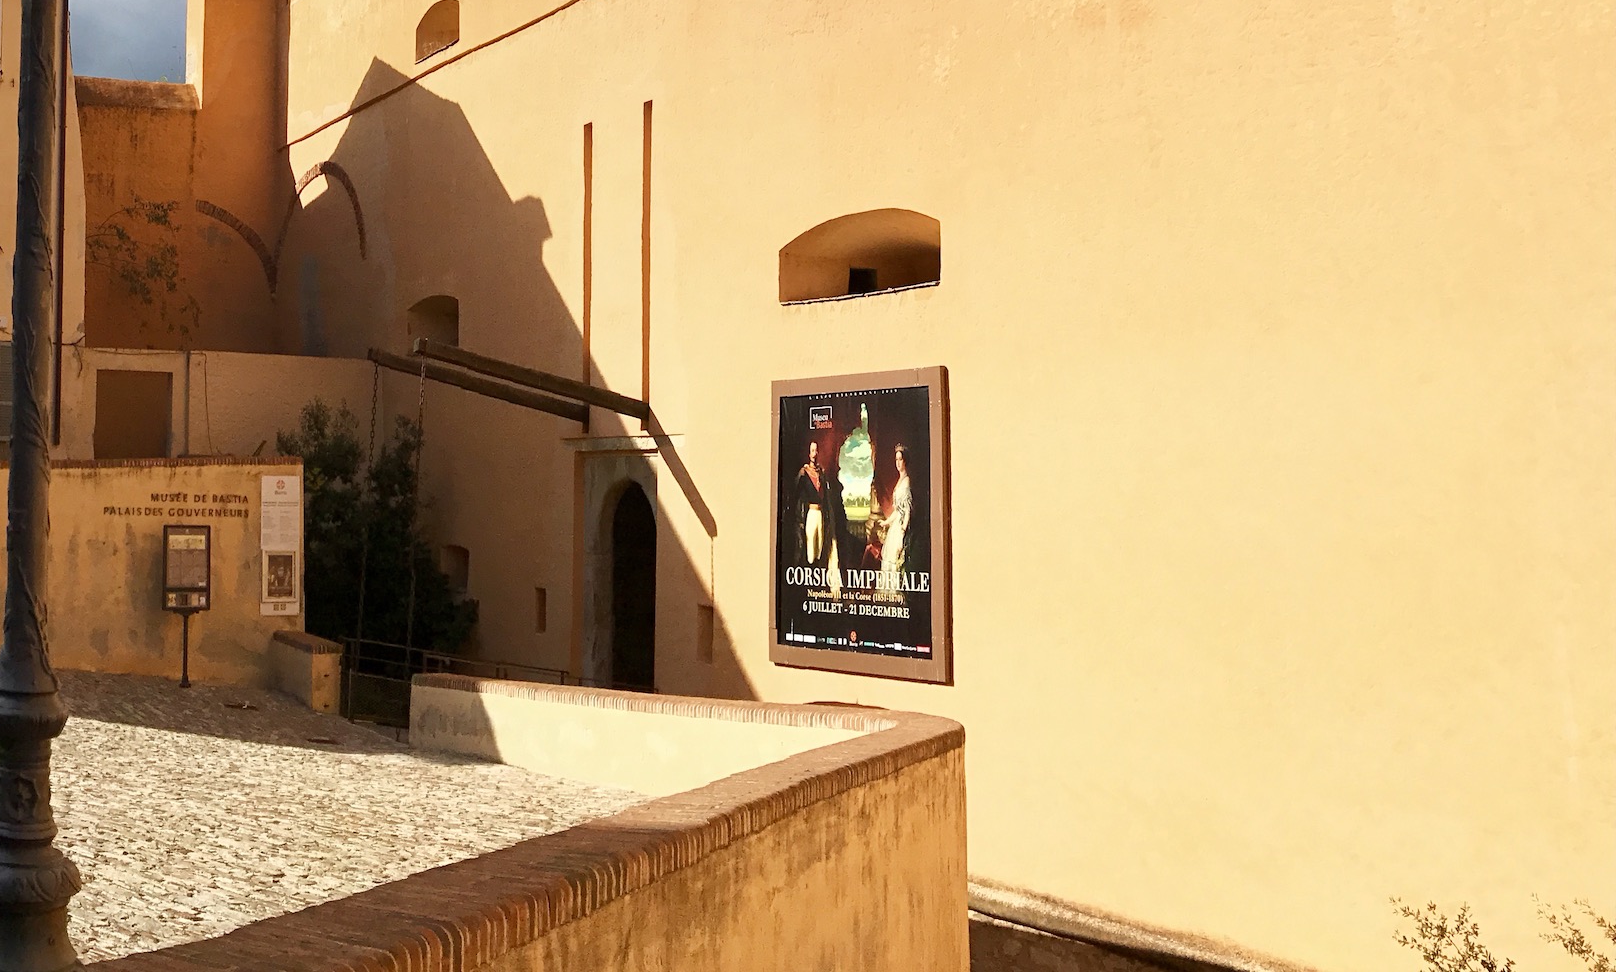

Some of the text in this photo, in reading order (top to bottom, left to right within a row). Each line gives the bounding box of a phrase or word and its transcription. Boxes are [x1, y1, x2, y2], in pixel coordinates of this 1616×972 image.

[150, 491, 249, 504] MUSÉE DE BASTIA
[103, 506, 250, 519] PALAIS DES GOUVERNEURS
[785, 566, 930, 593] CORSICA IMPERIALE
[807, 588, 833, 600] Napoléon
[842, 592, 849, 600] et
[849, 591, 855, 600] la
[855, 591, 872, 601] Corse
[802, 601, 808, 611] 6
[808, 601, 843, 614] JUILLET
[849, 604, 857, 615] 21
[858, 604, 911, 619] DECEMBRE
